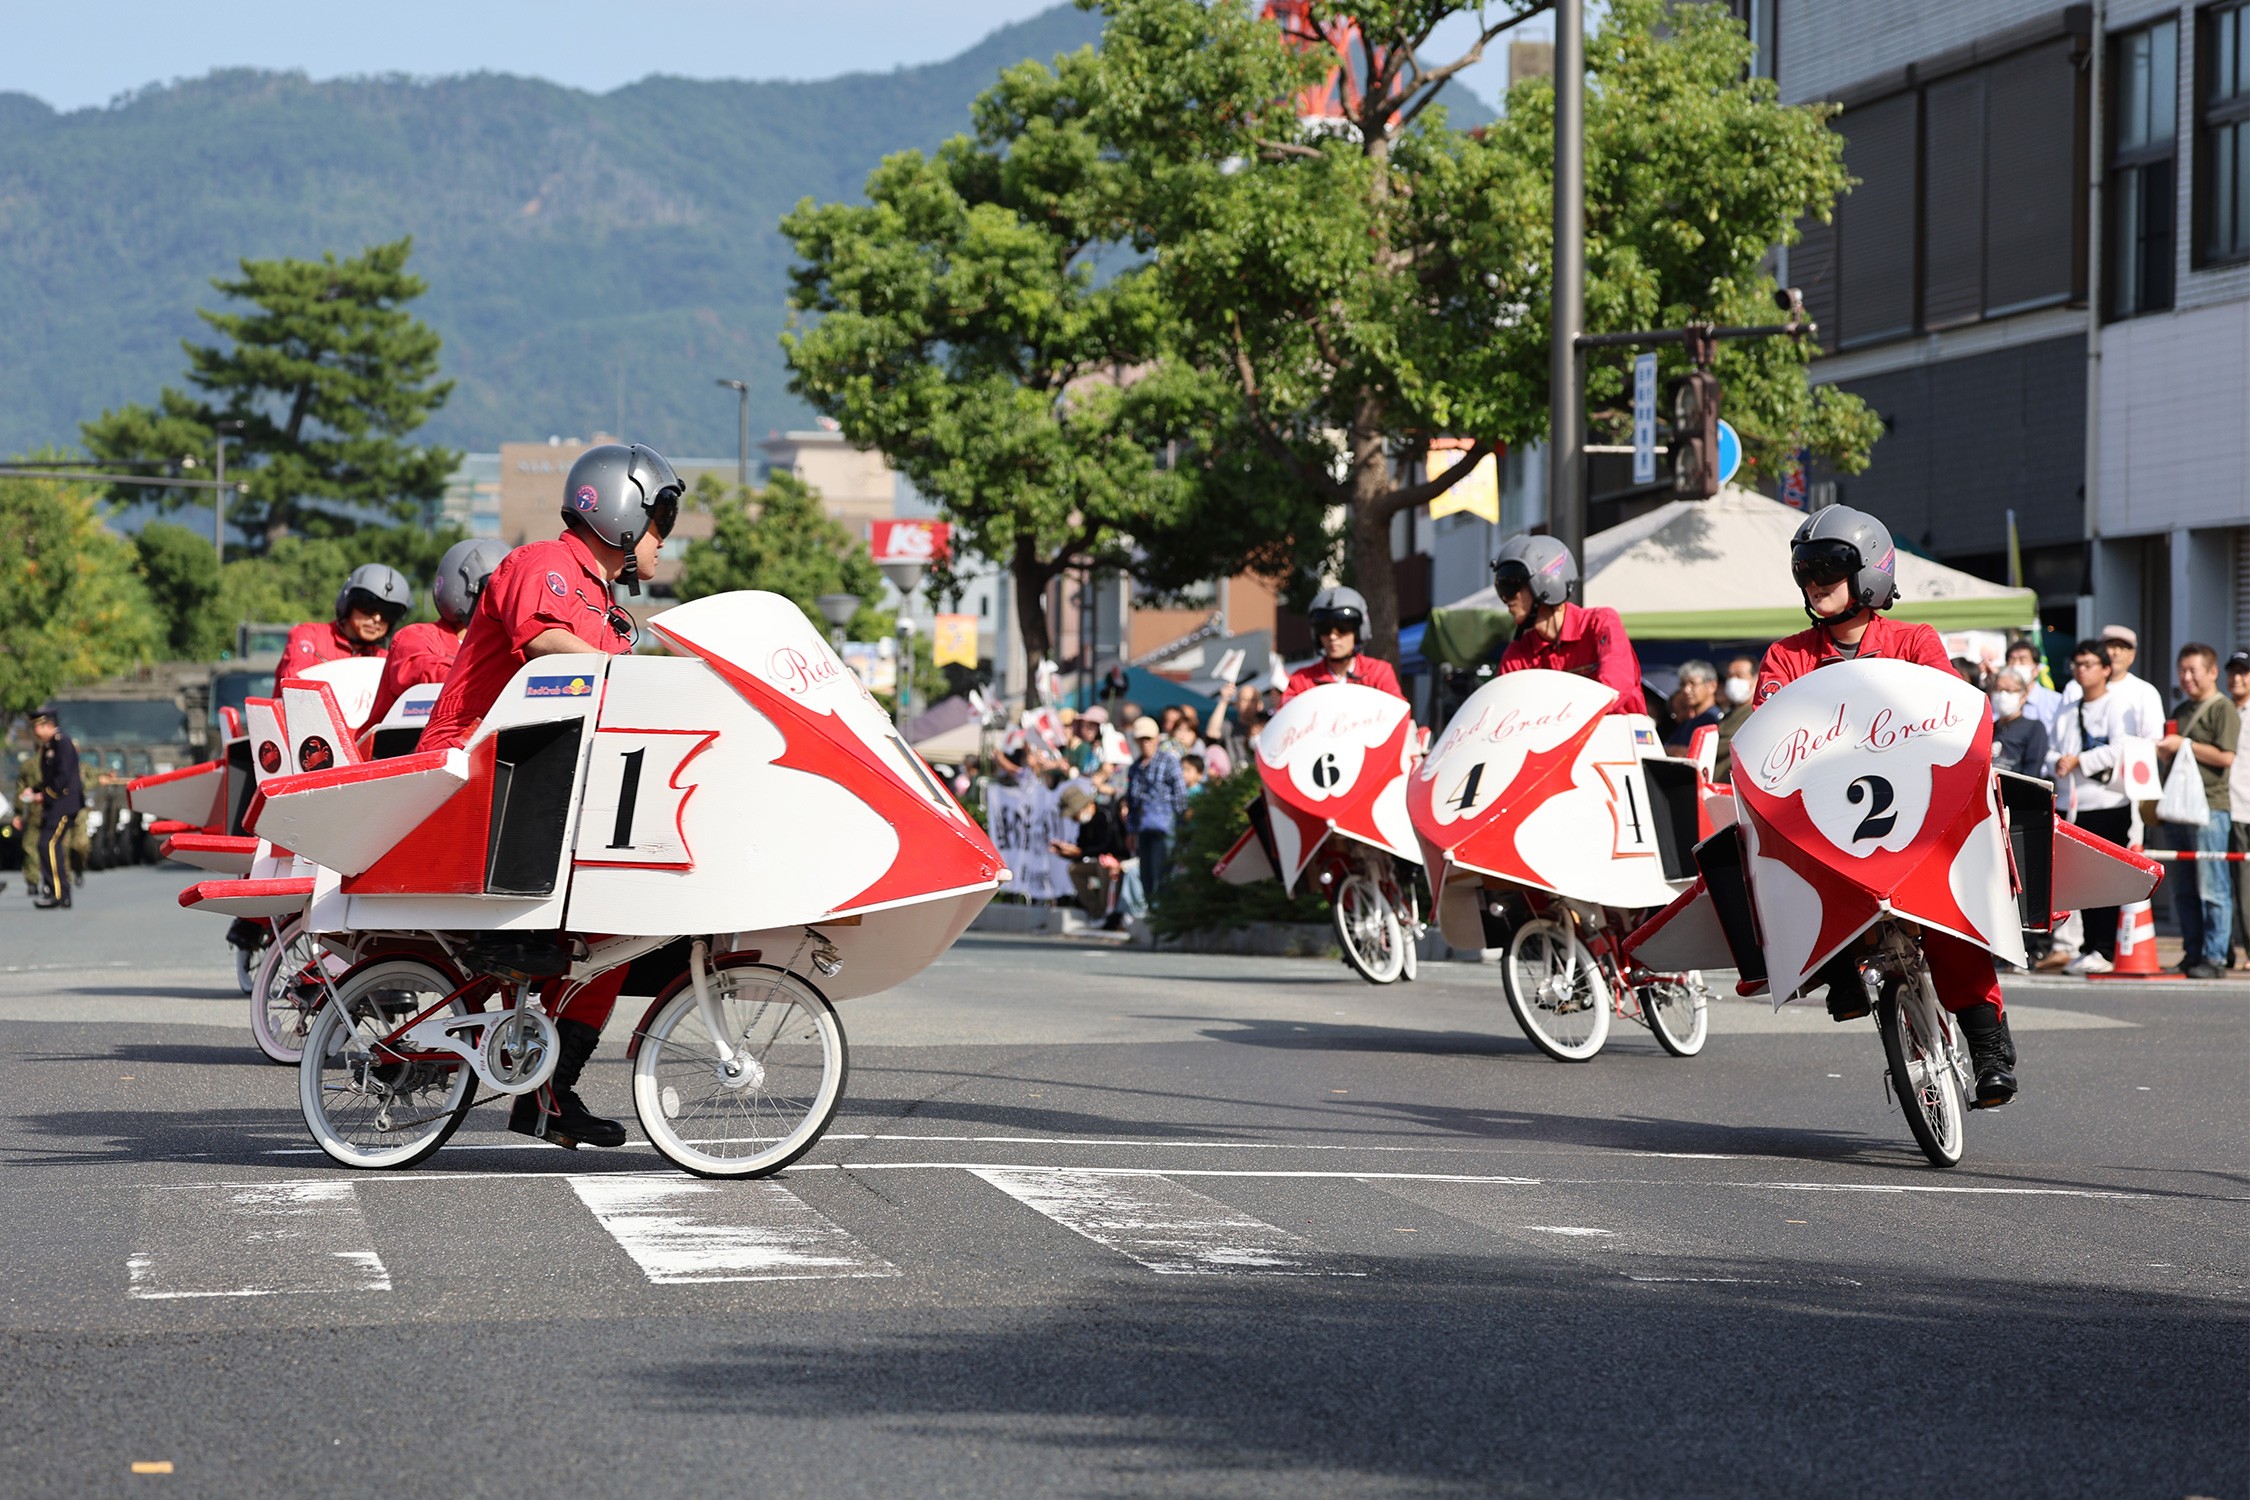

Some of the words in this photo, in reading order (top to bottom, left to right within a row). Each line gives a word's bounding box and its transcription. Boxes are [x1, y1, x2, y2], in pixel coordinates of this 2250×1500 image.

[771, 640, 839, 694] Red
[1274, 711, 1318, 755] Red
[1330, 710, 1386, 737] Crab
[1438, 706, 1490, 756] Red
[1490, 702, 1573, 740] Crab
[1771, 703, 1849, 783] Red
[1861, 701, 1964, 749] Crab
[605, 745, 647, 849] 1
[1312, 752, 1340, 789] 6
[1446, 761, 1487, 812] 4
[1846, 774, 1899, 845] 2
